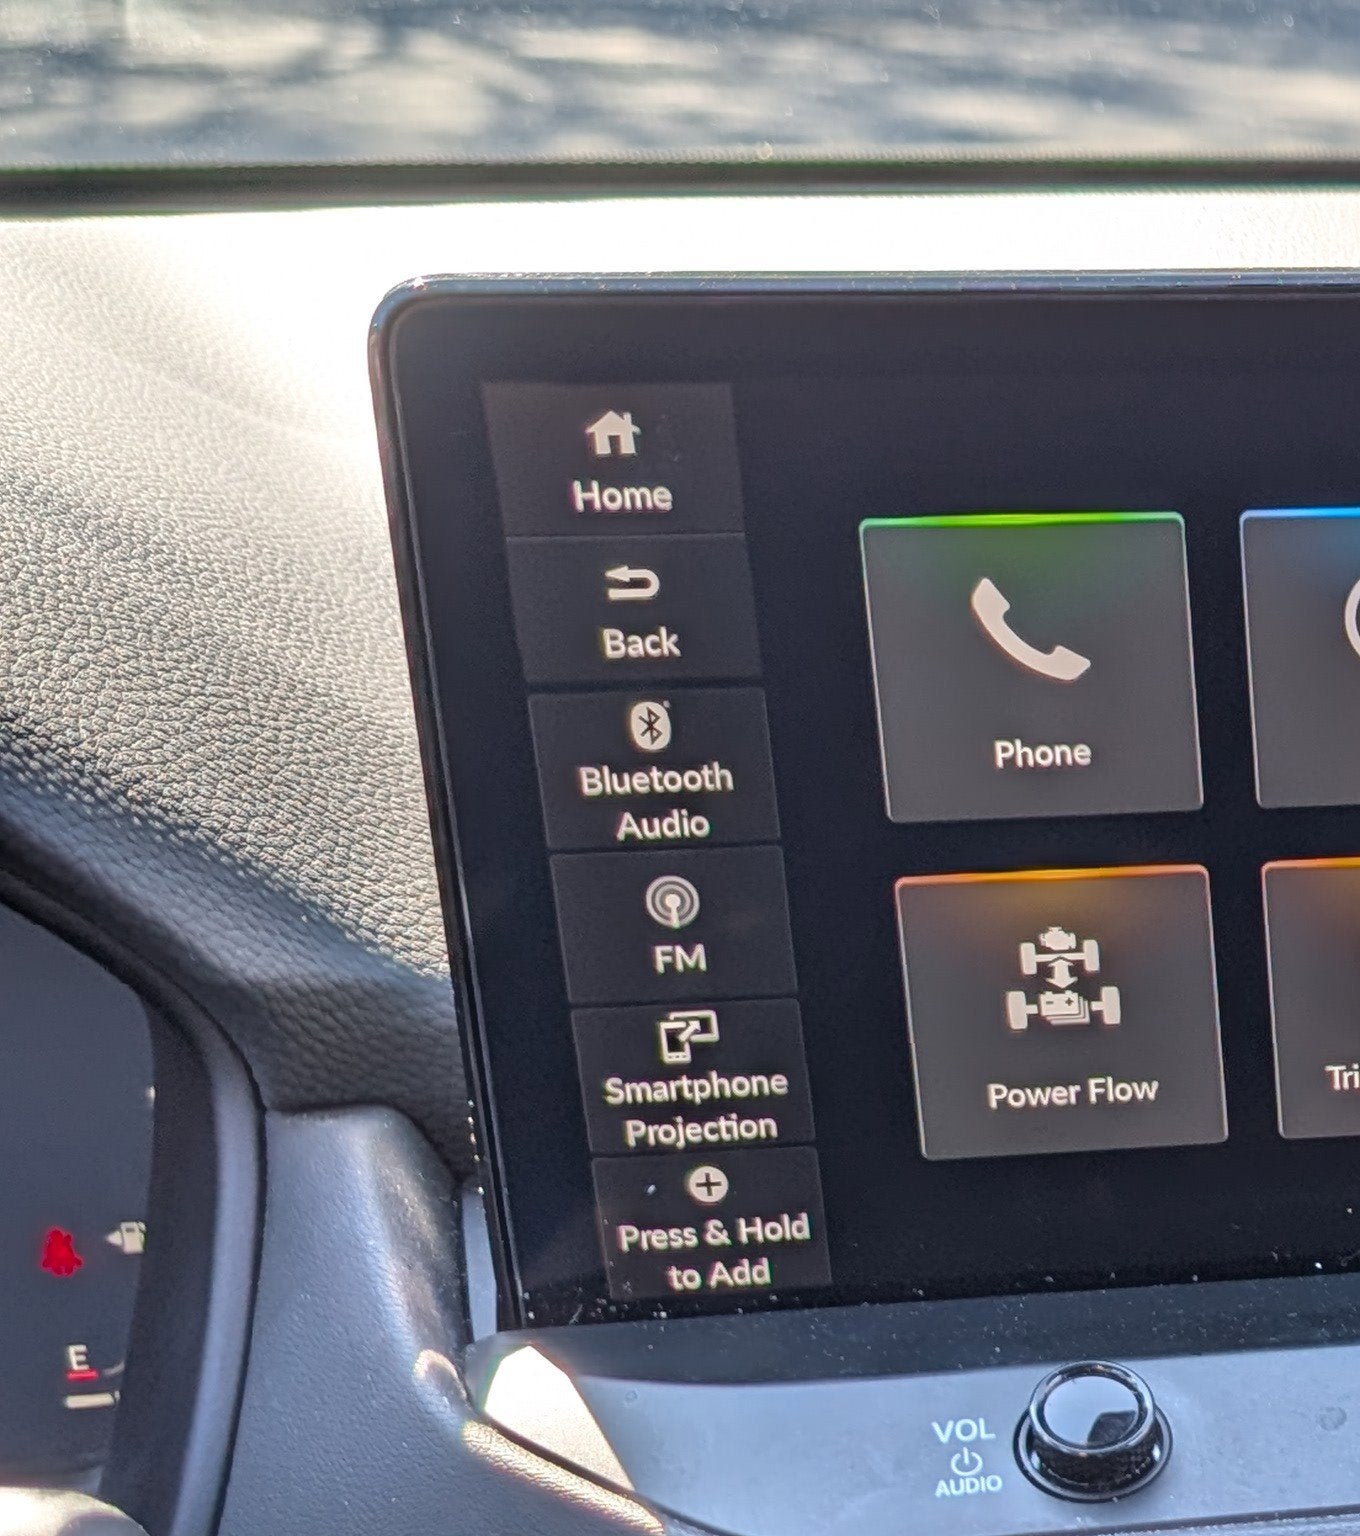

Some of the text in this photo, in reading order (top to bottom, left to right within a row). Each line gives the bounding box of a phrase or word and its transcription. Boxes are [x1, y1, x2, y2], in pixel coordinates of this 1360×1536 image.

[571, 479, 673, 513] Home
[602, 626, 681, 660] Back
[994, 738, 1092, 768] Phone
[578, 762, 734, 796] Bluetooth
[616, 808, 711, 841] Audio
[654, 943, 708, 974] FM
[604, 1070, 788, 1105] Smartphone
[988, 1076, 1159, 1109] Power Flow
[625, 1113, 778, 1149] Projection
[616, 1213, 812, 1253] Press & Hold
[668, 1257, 772, 1291] to Add
[68, 1344, 90, 1371] E
[932, 1417, 996, 1443] VOL
[935, 1474, 1003, 1497] AUDIO
